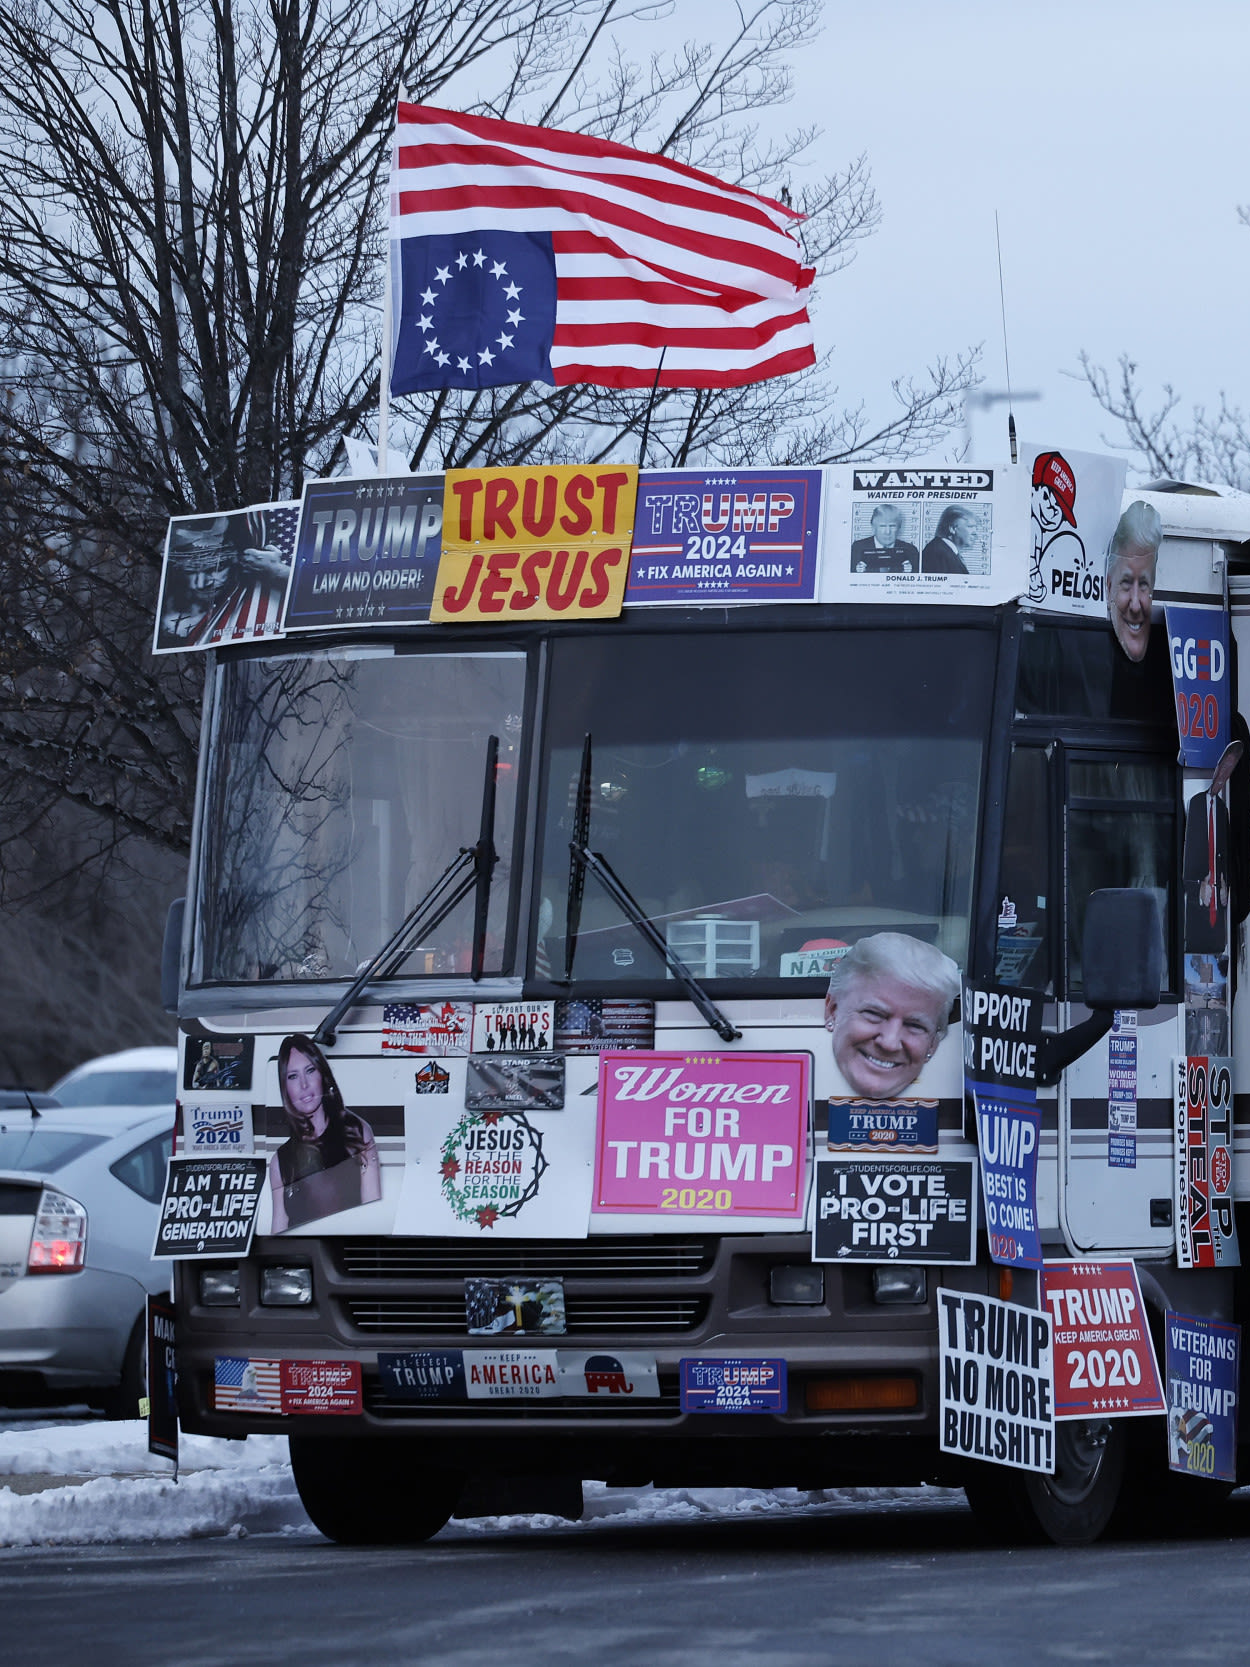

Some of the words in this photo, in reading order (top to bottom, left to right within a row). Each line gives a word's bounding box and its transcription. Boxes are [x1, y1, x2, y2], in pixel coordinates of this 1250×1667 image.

[856, 472, 991, 488] WANTED
[452, 472, 629, 541] TRUST
[867, 491, 907, 500] WANTED
[909, 491, 926, 500] FOR
[929, 491, 978, 500] PRESIDENT
[646, 493, 795, 535] TRUMP
[311, 504, 443, 564] TRUMP
[685, 536, 747, 560] 2024
[313, 574, 338, 594] LAW
[340, 571, 370, 592] AND
[373, 570, 423, 590] ORDER!
[442, 548, 622, 614] JESUS
[648, 566, 668, 579] FIX
[672, 565, 732, 578] AMERICA
[736, 564, 782, 577] AGAIN
[1052, 569, 1104, 602] PELOSI
[493, 1005, 523, 1014] SUPPORT
[485, 1013, 549, 1032] TROOPS
[1111, 1041, 1135, 1052] TRUMP
[981, 1037, 1036, 1079] POLICE
[614, 1066, 791, 1104] Women
[1109, 1070, 1136, 1080] WOMEN
[191, 1108, 243, 1122] Trump
[664, 1107, 740, 1138] FOR
[849, 1115, 918, 1130] TRUMP
[196, 1131, 240, 1144] 2020
[465, 1130, 524, 1150] JESUS
[872, 1131, 895, 1140] 2020
[465, 1161, 521, 1174] REASON
[466, 1152, 480, 1161] IS
[486, 1152, 521, 1161] THE
[608, 1141, 794, 1182] TRUMP
[1177, 1062, 1190, 1263] #StopTheSteal
[1189, 1063, 1211, 1263] STEAL
[465, 1175, 490, 1185] FOR
[494, 1175, 521, 1185] THE
[849, 1165, 941, 1173] STUDENTSFORLIFE.ORG
[173, 1174, 179, 1192] I
[184, 1175, 211, 1191] AM
[219, 1173, 257, 1190] THE
[463, 1185, 519, 1199] SEASON
[839, 1175, 847, 1195] I
[860, 1174, 945, 1196] VOTE
[986, 1174, 1012, 1199] BEST
[1015, 1175, 1027, 1202] IS
[164, 1194, 257, 1219] PRO-LIFE
[661, 1188, 732, 1210] 2020
[820, 1197, 966, 1221] PRO-LIFE
[852, 1222, 933, 1246] FIRST
[1212, 1225, 1222, 1260] THE
[1047, 1288, 1136, 1326] TRUMP
[941, 1295, 1049, 1370] TRUMP
[1054, 1331, 1077, 1344] KEEP
[1079, 1330, 1113, 1343] AMERICA
[1114, 1329, 1141, 1342] GREAT!
[1171, 1327, 1236, 1361] VETERANS
[397, 1357, 448, 1367] RE-ELECT
[500, 1354, 520, 1362] KEEP
[1067, 1349, 1141, 1389] 2020
[288, 1367, 352, 1386] TRUMP
[393, 1367, 454, 1385] TRUMP
[471, 1364, 556, 1384] AMERICA
[692, 1367, 774, 1385] TRUMP
[1189, 1357, 1212, 1382] FOR
[308, 1386, 334, 1397] 2024
[717, 1386, 750, 1397] 2024
[944, 1356, 979, 1404] NO
[986, 1366, 1051, 1422] MORE
[1170, 1378, 1236, 1417] TRUMP
[716, 1398, 751, 1406] MAGA
[944, 1408, 1052, 1469] BULLSHIT!
[1187, 1440, 1214, 1474] 2020
